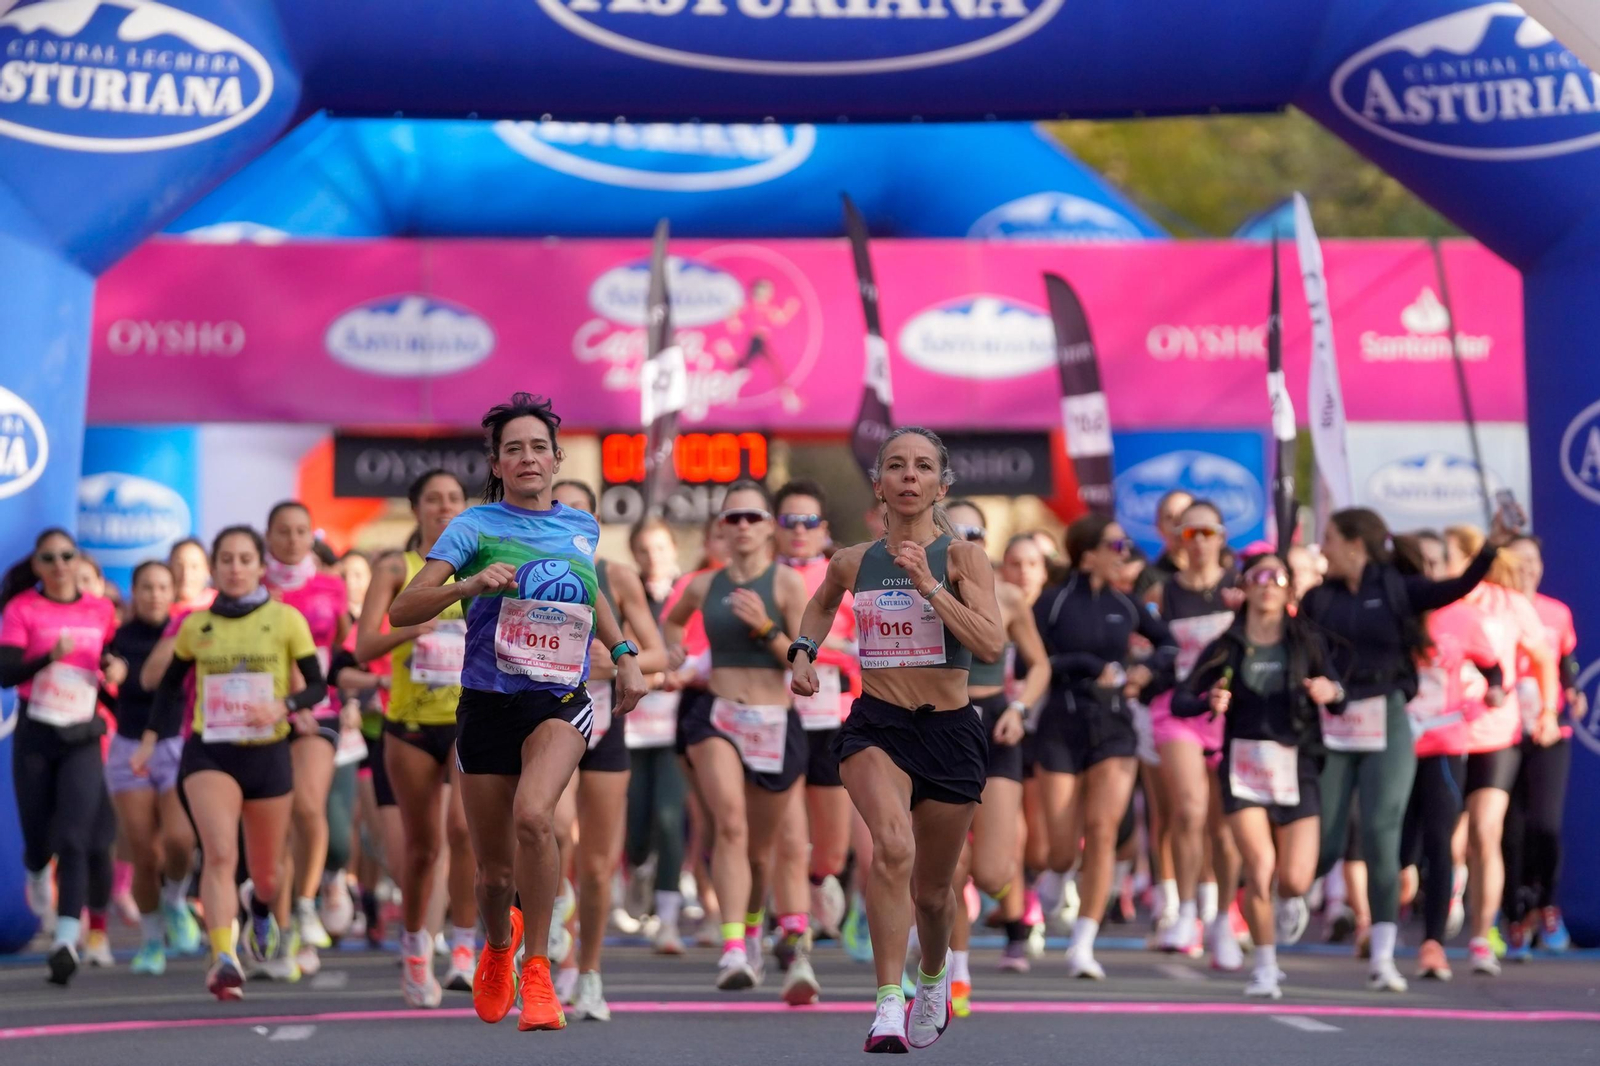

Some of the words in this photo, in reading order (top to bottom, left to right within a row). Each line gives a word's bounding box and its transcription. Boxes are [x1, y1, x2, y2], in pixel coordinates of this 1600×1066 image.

[7, 39, 118, 65] CENTRAL
[126, 47, 241, 73] LECHERA
[0, 60, 245, 117] STURIANA
[106, 320, 246, 358] OYSHO
[547, 582, 578, 602] JD
[878, 598, 911, 607] ASTURIANA
[530, 611, 564, 622] ASTURIANA
[880, 621, 913, 636] 016
[526, 633, 560, 650] 016
[536, 653, 546, 661] 22
[864, 659, 889, 667] OYSHO
[906, 659, 935, 667] Santander
[505, 663, 533, 676] OYSHO
